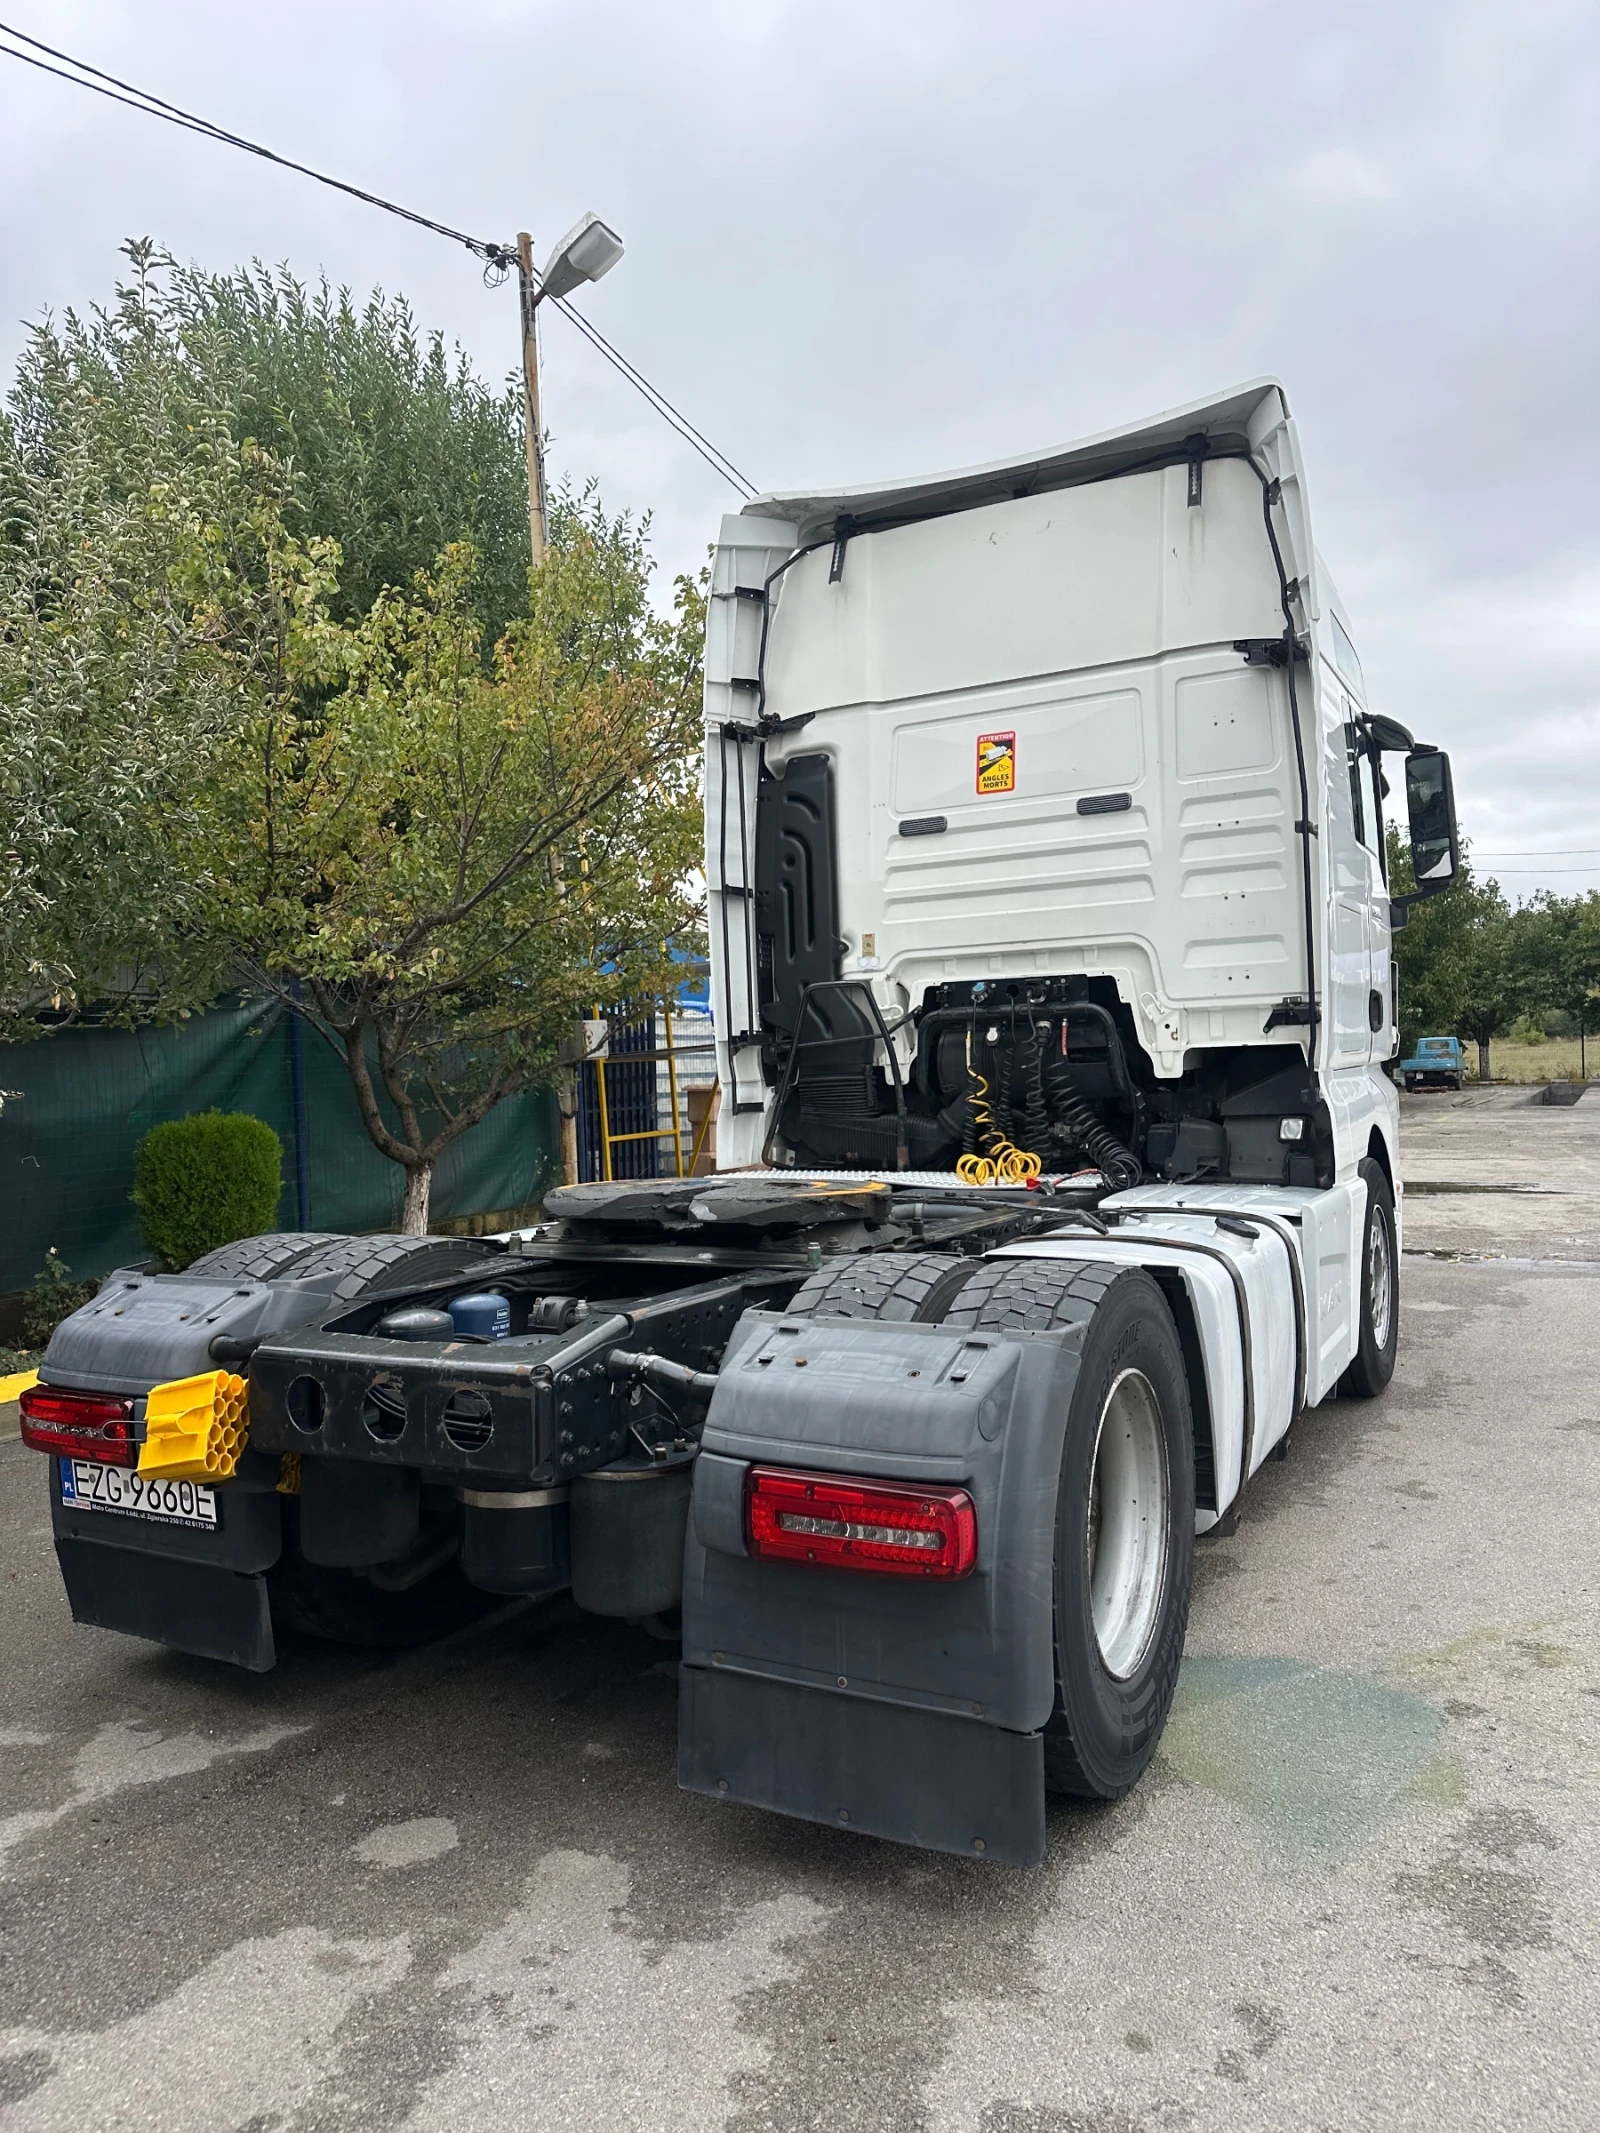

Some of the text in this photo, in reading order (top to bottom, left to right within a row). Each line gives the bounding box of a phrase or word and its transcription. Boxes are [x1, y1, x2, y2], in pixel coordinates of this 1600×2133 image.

[980, 732, 1014, 742] ATTENTION
[982, 773, 1010, 782] ANGLES
[983, 780, 1008, 789] MORTS
[64, 1481, 75, 1493] PL
[73, 1461, 213, 1520] EZG 9660E
[104, 1506, 126, 1516] Centrum
[147, 1513, 169, 1523] Zgierska
